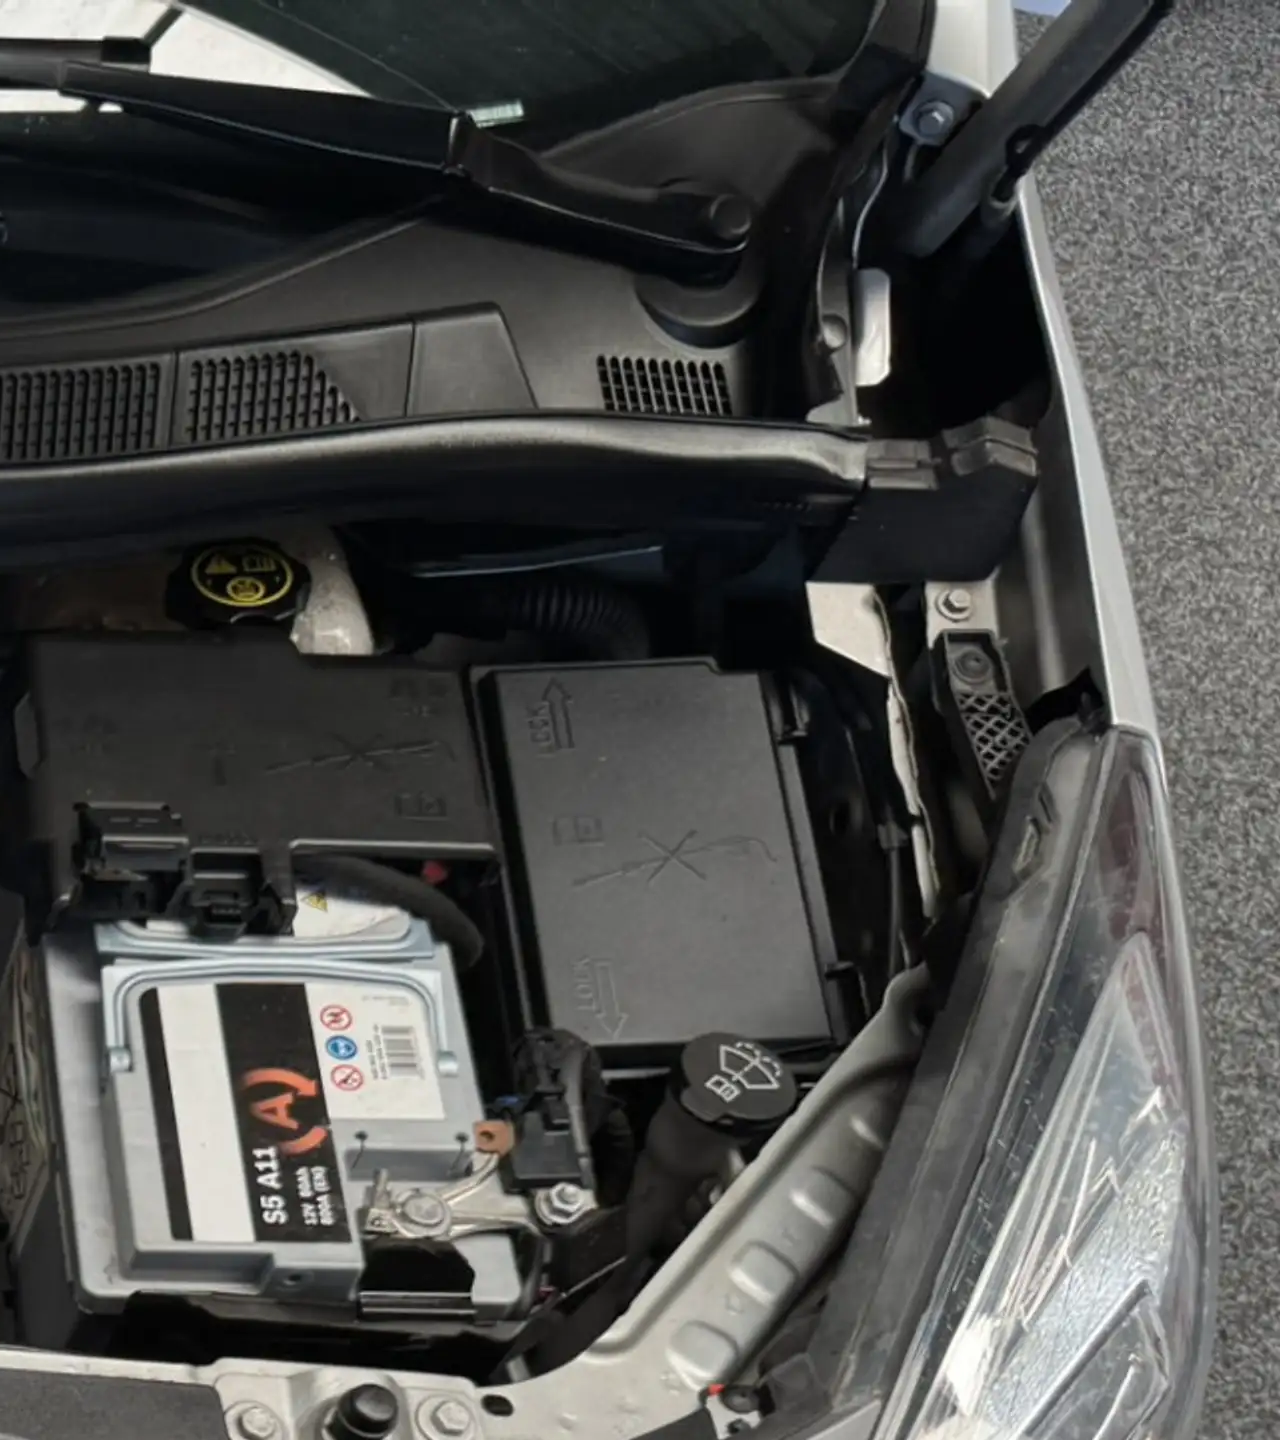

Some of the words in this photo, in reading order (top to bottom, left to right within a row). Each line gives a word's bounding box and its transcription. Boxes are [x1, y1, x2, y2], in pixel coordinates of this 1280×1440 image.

[570, 956, 596, 1011] LOCK
[251, 1145, 283, 1190] A11
[259, 1194, 289, 1226] S5
